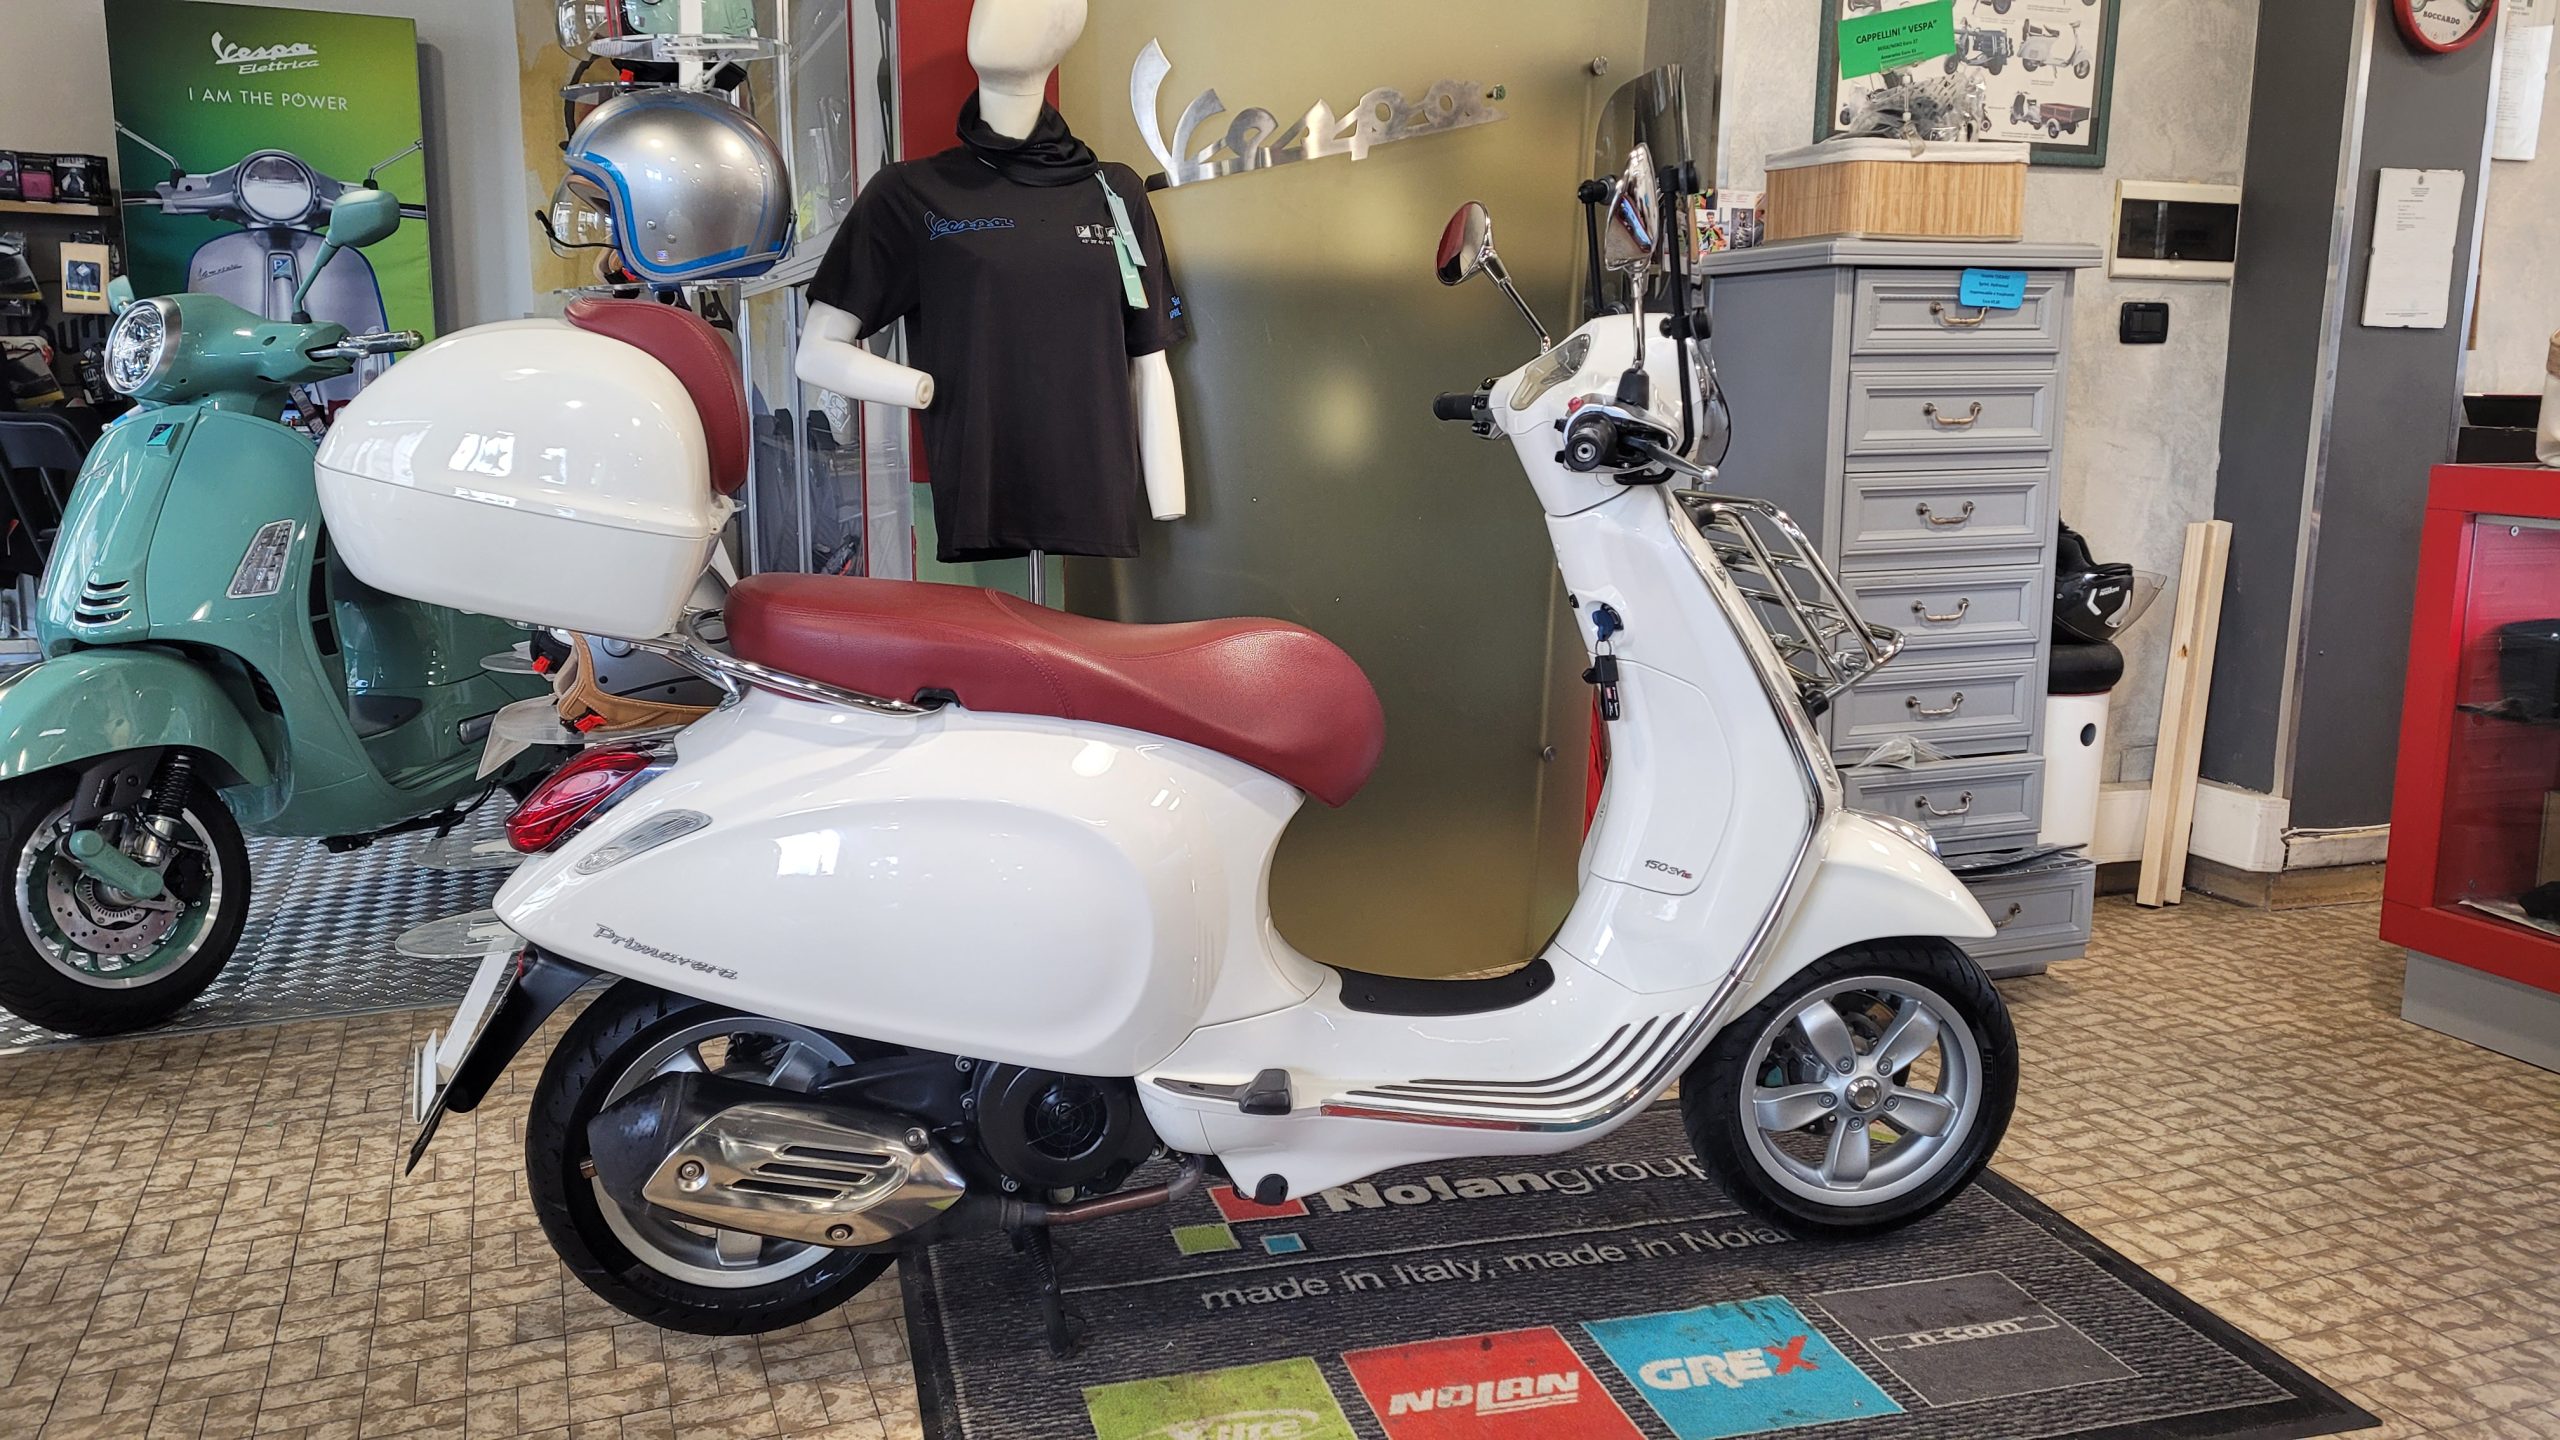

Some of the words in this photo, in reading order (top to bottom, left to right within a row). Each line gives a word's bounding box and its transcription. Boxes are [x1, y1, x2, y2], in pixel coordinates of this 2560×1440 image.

[211, 31, 318, 65] Vespa
[1856, 28, 1900, 44] CAPPELLINI
[238, 59, 320, 75] Elettrica
[188, 87, 193, 101] I
[202, 88, 232, 104] AM
[240, 90, 273, 106] THE
[282, 92, 349, 112] POWER
[1130, 37, 1508, 188] Vespa
[924, 211, 1016, 240] Vespa
[1645, 860, 1668, 872] 150
[593, 923, 738, 980] Primavera
[1202, 1272, 1329, 1310] made
[1340, 1268, 1383, 1293] in
[1399, 1256, 1497, 1285] Italy,
[1503, 1241, 1626, 1273] made
[1632, 1237, 1678, 1258] in
[1678, 1224, 1798, 1252] Nola
[1908, 1321, 2024, 1346] n-com
[1638, 1335, 1820, 1391] GREX
[1388, 1371, 1579, 1417] NOLAN
